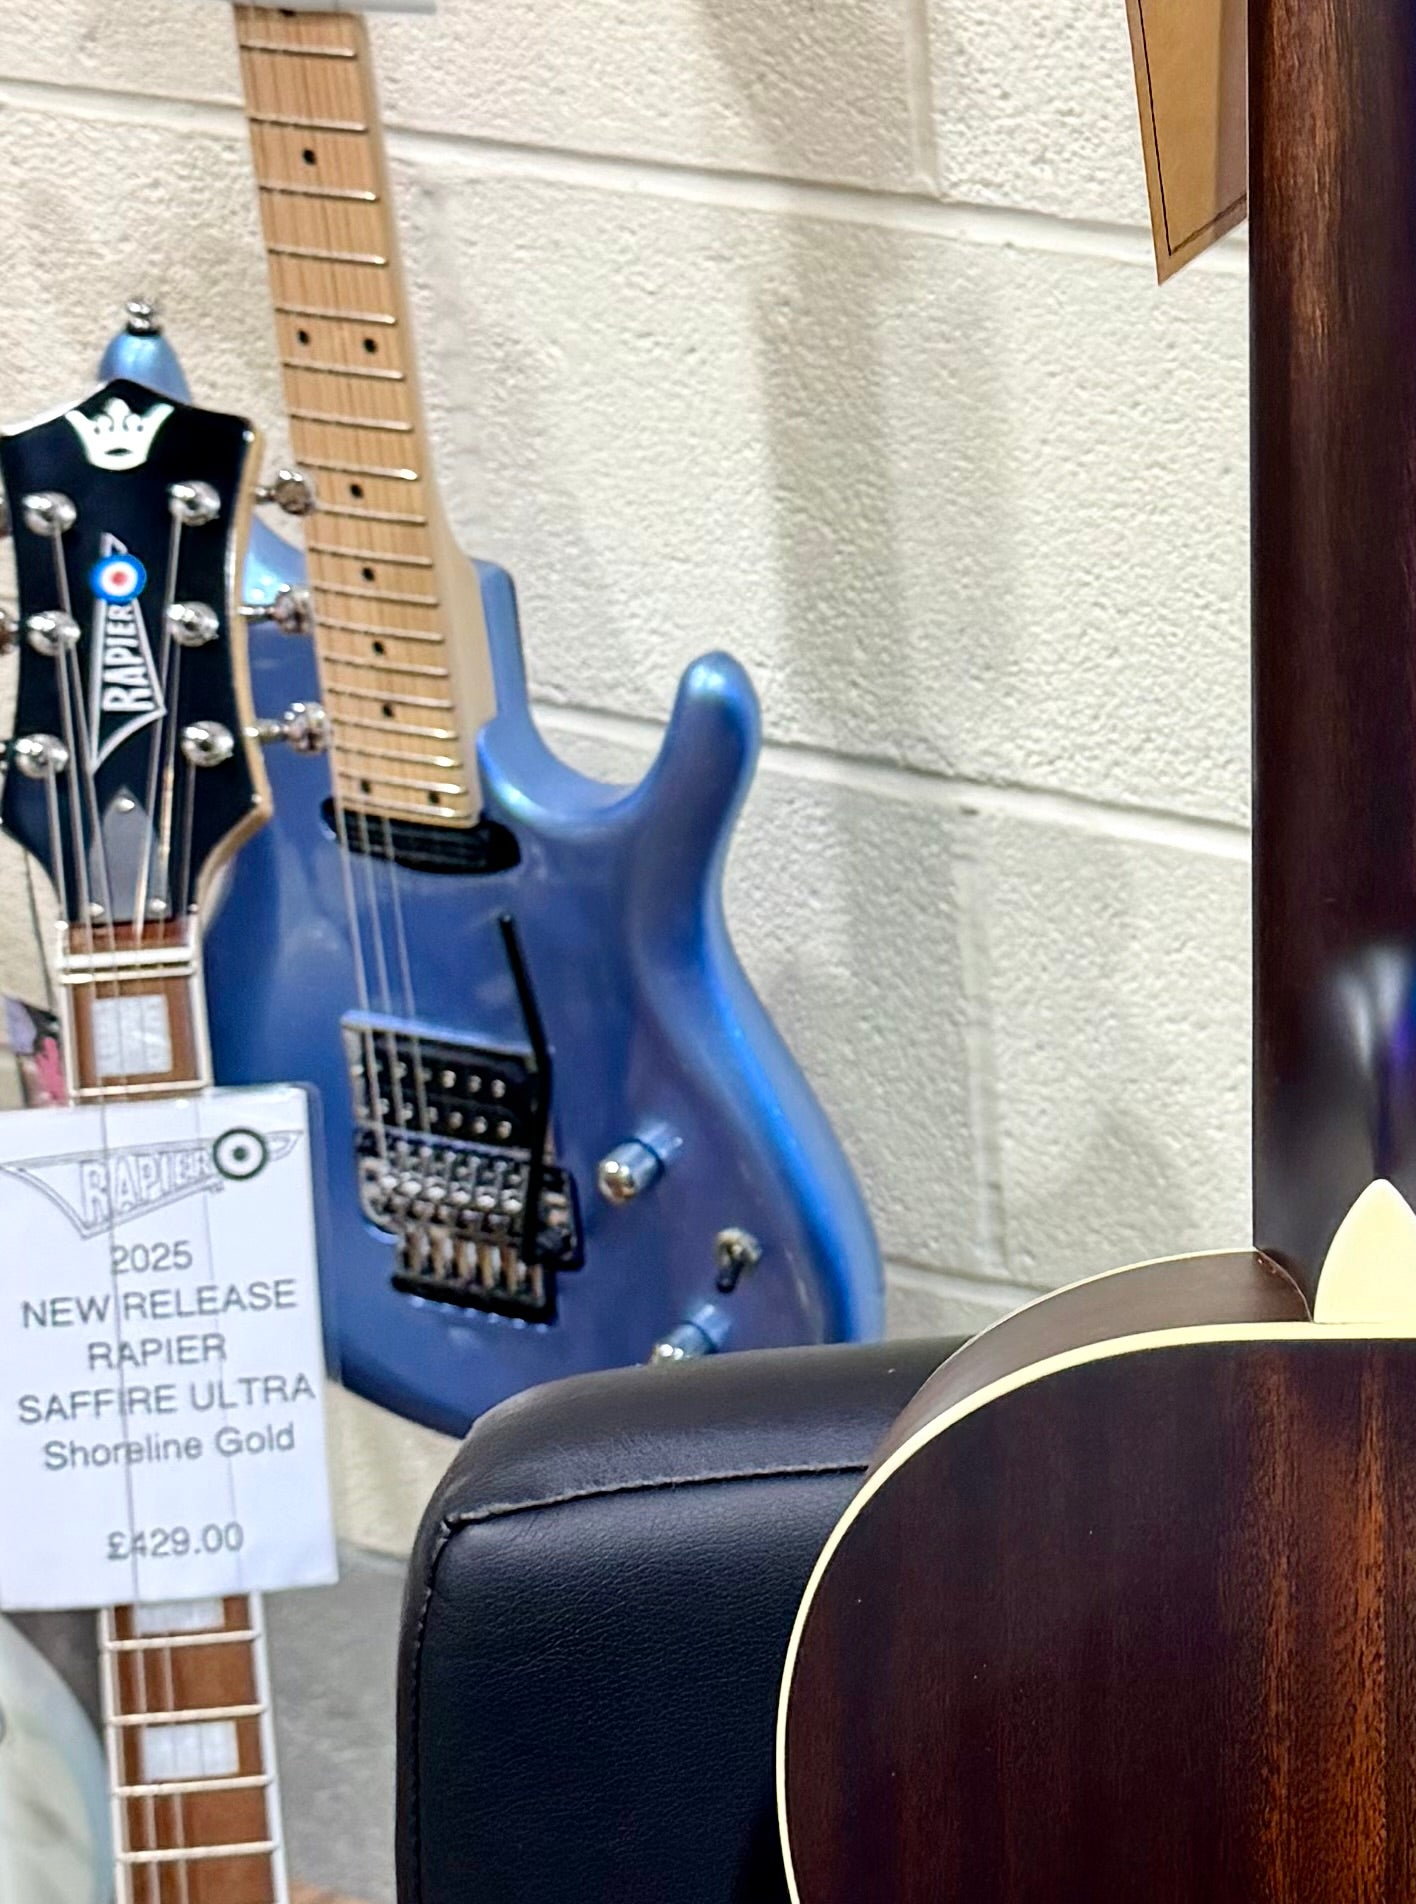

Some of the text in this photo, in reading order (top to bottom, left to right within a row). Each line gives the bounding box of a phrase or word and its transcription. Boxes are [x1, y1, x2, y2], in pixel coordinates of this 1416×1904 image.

[101, 603, 157, 713] RAPIER
[79, 1147, 213, 1231] RAPIER
[110, 1241, 194, 1276] 2025
[21, 1279, 298, 1329] NEW RELEASE
[87, 1333, 227, 1371] RAPIER
[18, 1372, 317, 1425] SAFFIRE ULTRA
[43, 1421, 296, 1471] Shoreline Gold
[107, 1520, 245, 1561] £429.00
